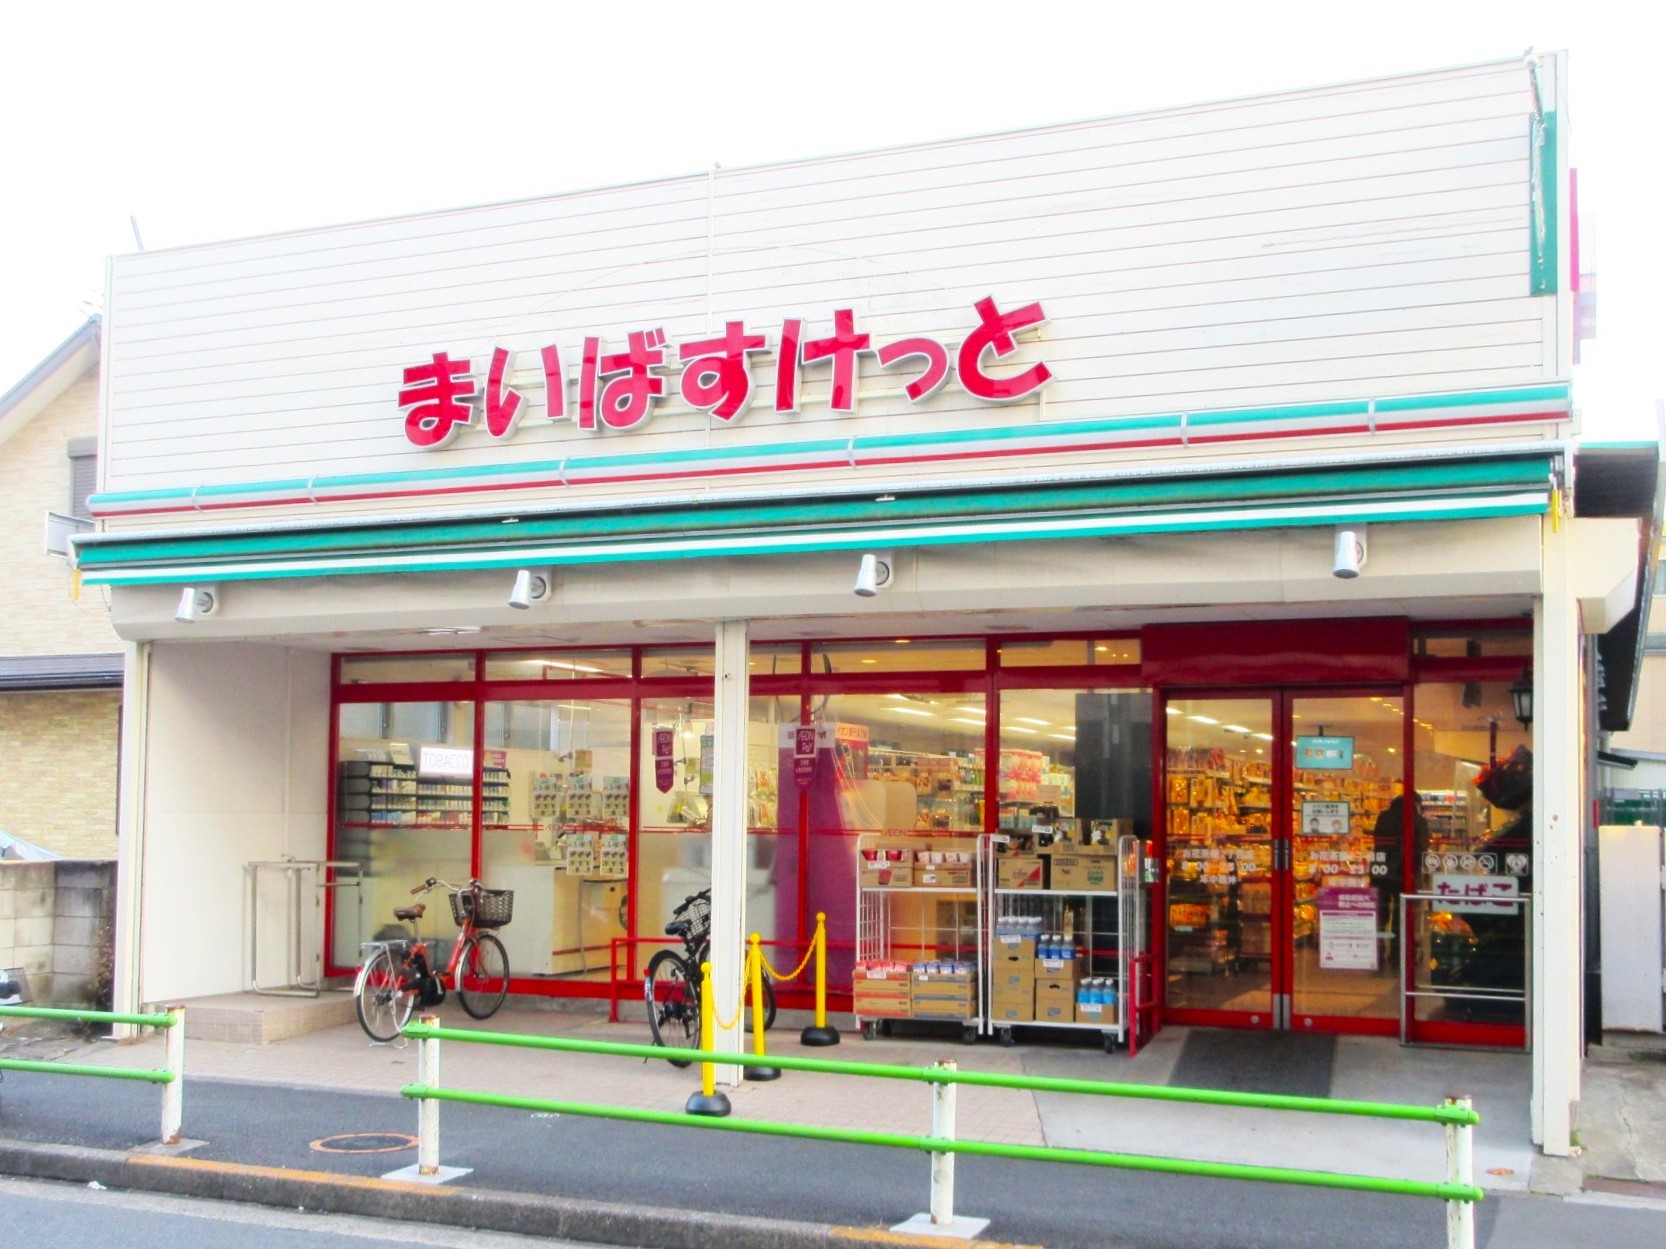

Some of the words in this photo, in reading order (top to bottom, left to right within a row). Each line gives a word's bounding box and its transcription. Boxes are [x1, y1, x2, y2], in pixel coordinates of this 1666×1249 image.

[398, 295, 1052, 450] まいばすけっと
[422, 753, 470, 770] TOBACCO
[1437, 881, 1514, 907] たばこ
